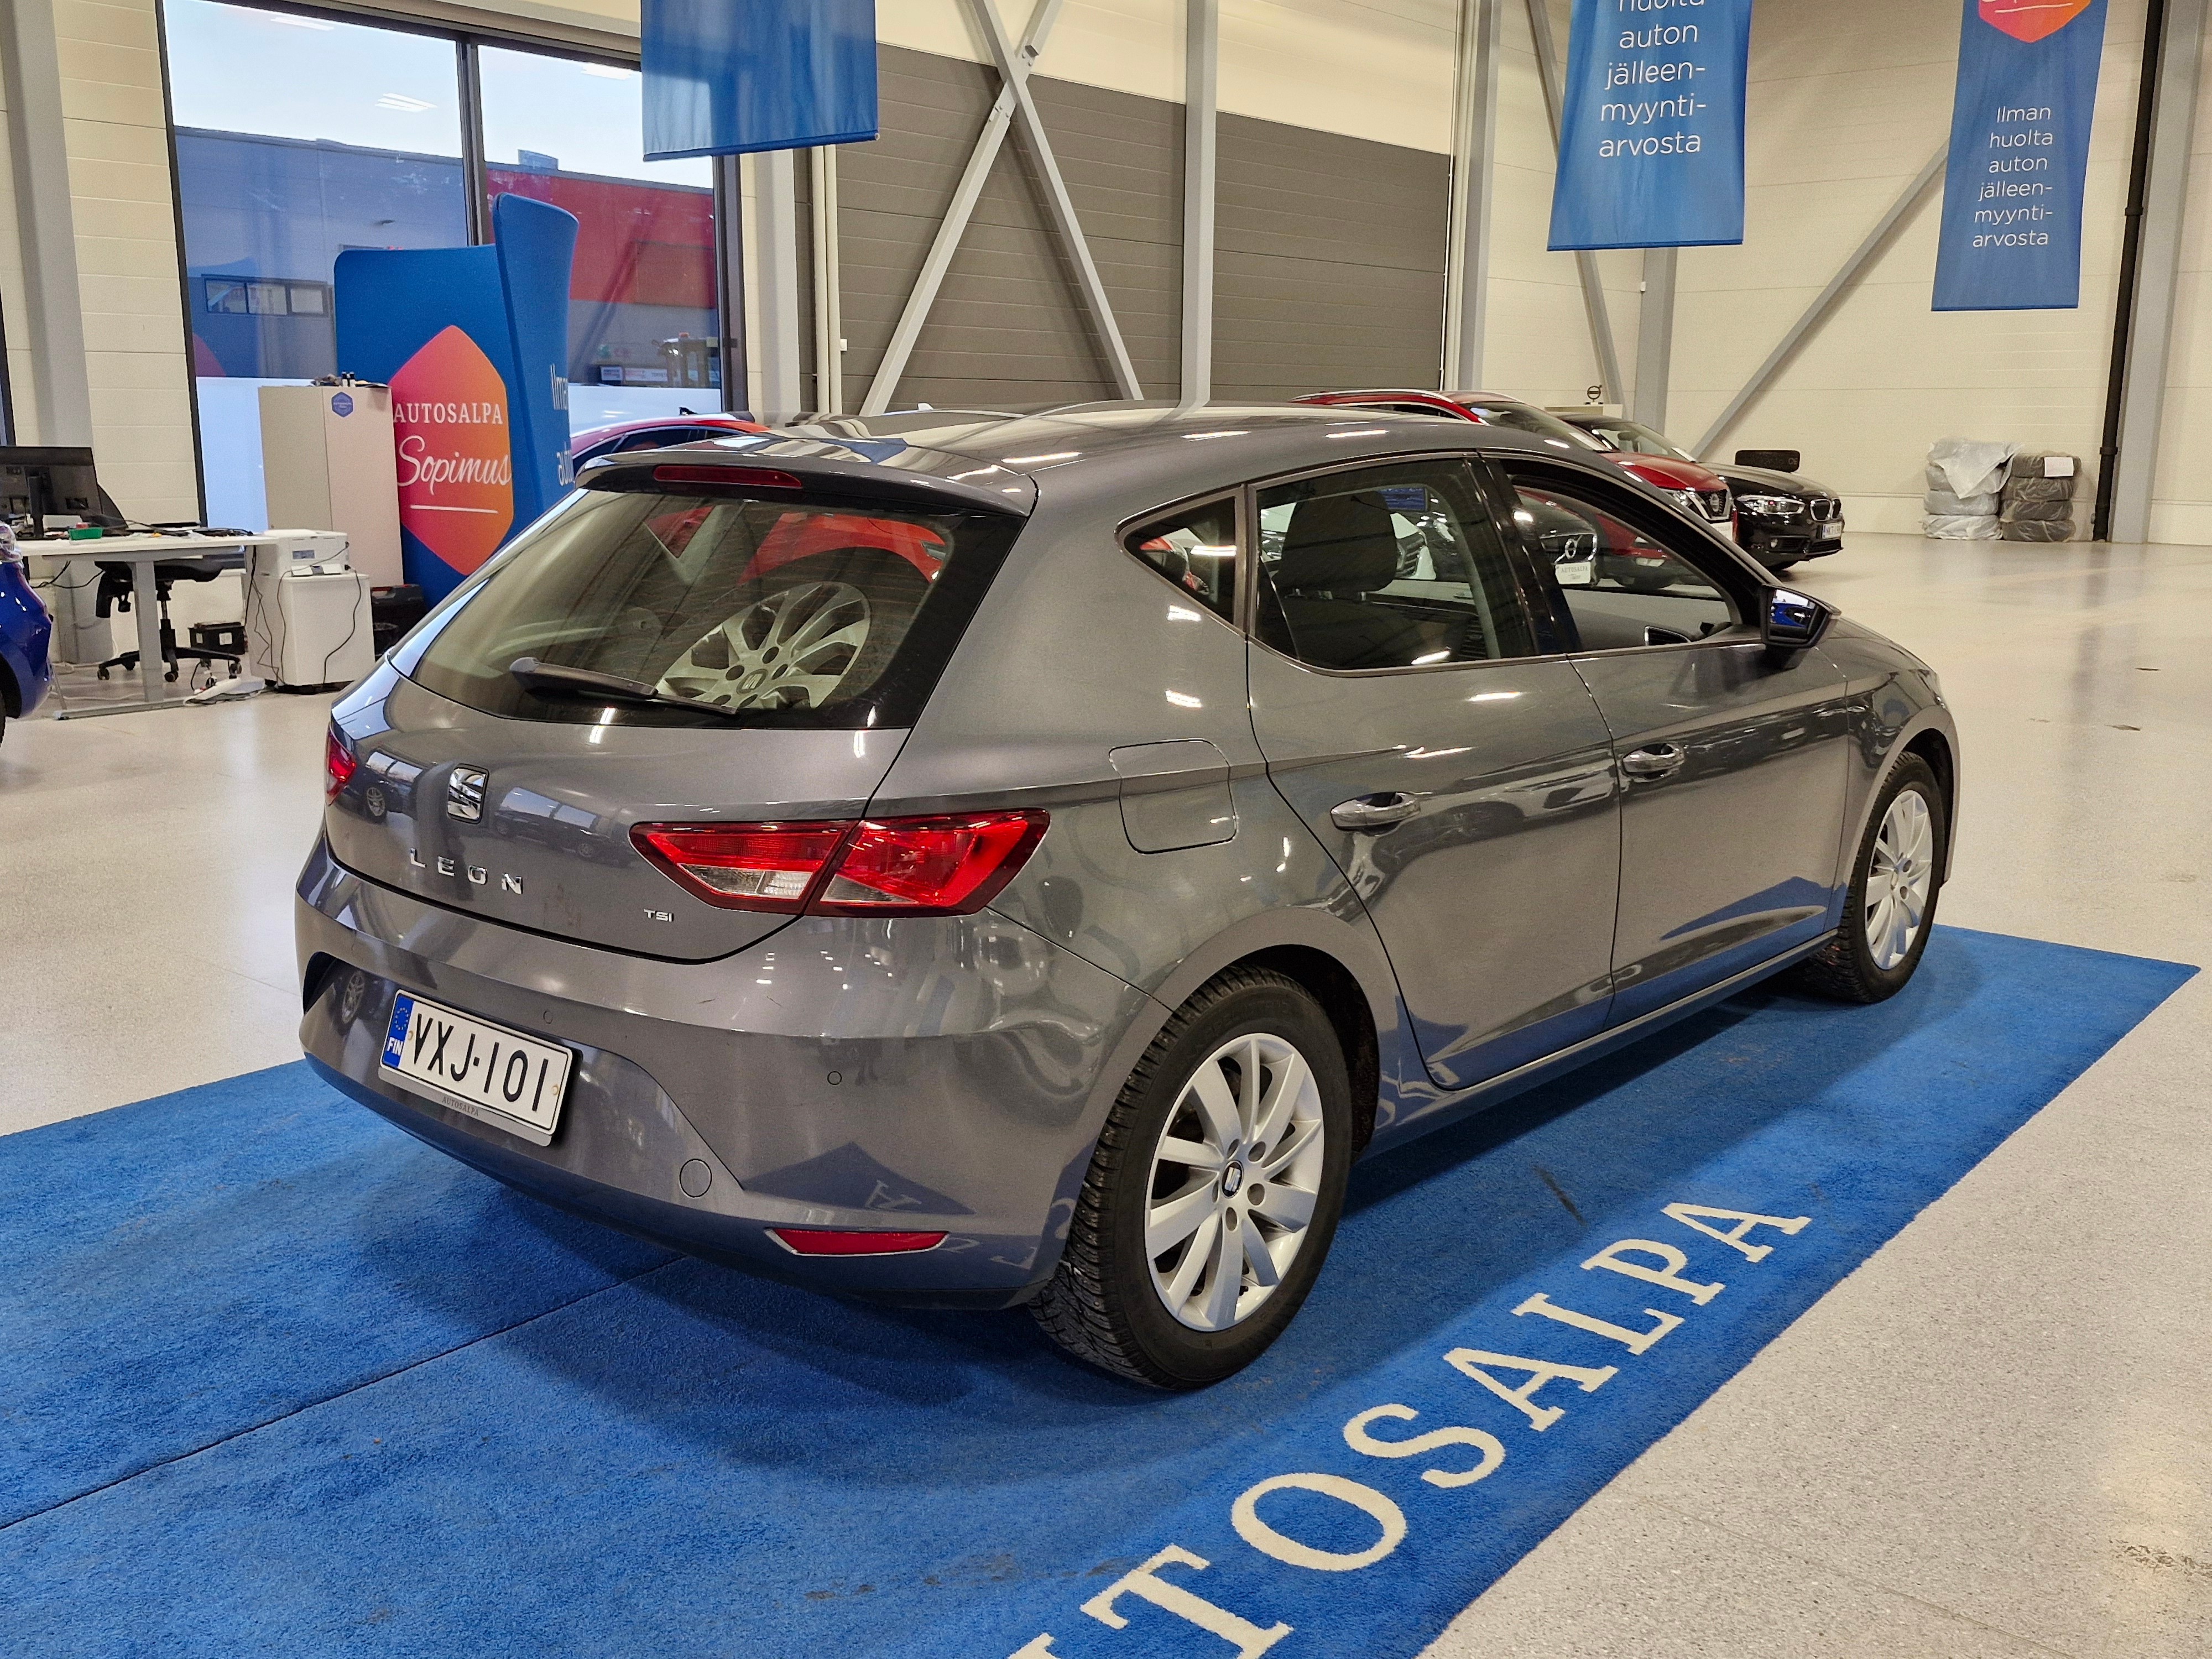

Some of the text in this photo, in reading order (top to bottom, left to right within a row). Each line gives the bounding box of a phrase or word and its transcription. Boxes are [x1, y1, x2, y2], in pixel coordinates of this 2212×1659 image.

[1619, 23, 1698, 49] auton
[1604, 60, 1705, 90] jälleen-
[1601, 92, 1707, 126] myynti-
[1997, 106, 2051, 123] Ilman
[1599, 131, 1700, 157] arvosta
[1990, 128, 2053, 149] huolta
[1989, 155, 2048, 173] auton
[1978, 180, 2053, 202] jälleen-
[1975, 204, 2053, 226] myynti-
[1973, 229, 2048, 248] arvosta
[393, 402, 503, 425] AUTOSALPA
[397, 435, 512, 495] Sopimus
[409, 847, 523, 895] LEON
[643, 909, 674, 922] TSI
[387, 1036, 404, 1056] FIN
[414, 1013, 549, 1112] VXJ-101
[442, 1096, 479, 1117] AUTOSALPA
[1006, 1200, 1813, 1659] TOSALPA
